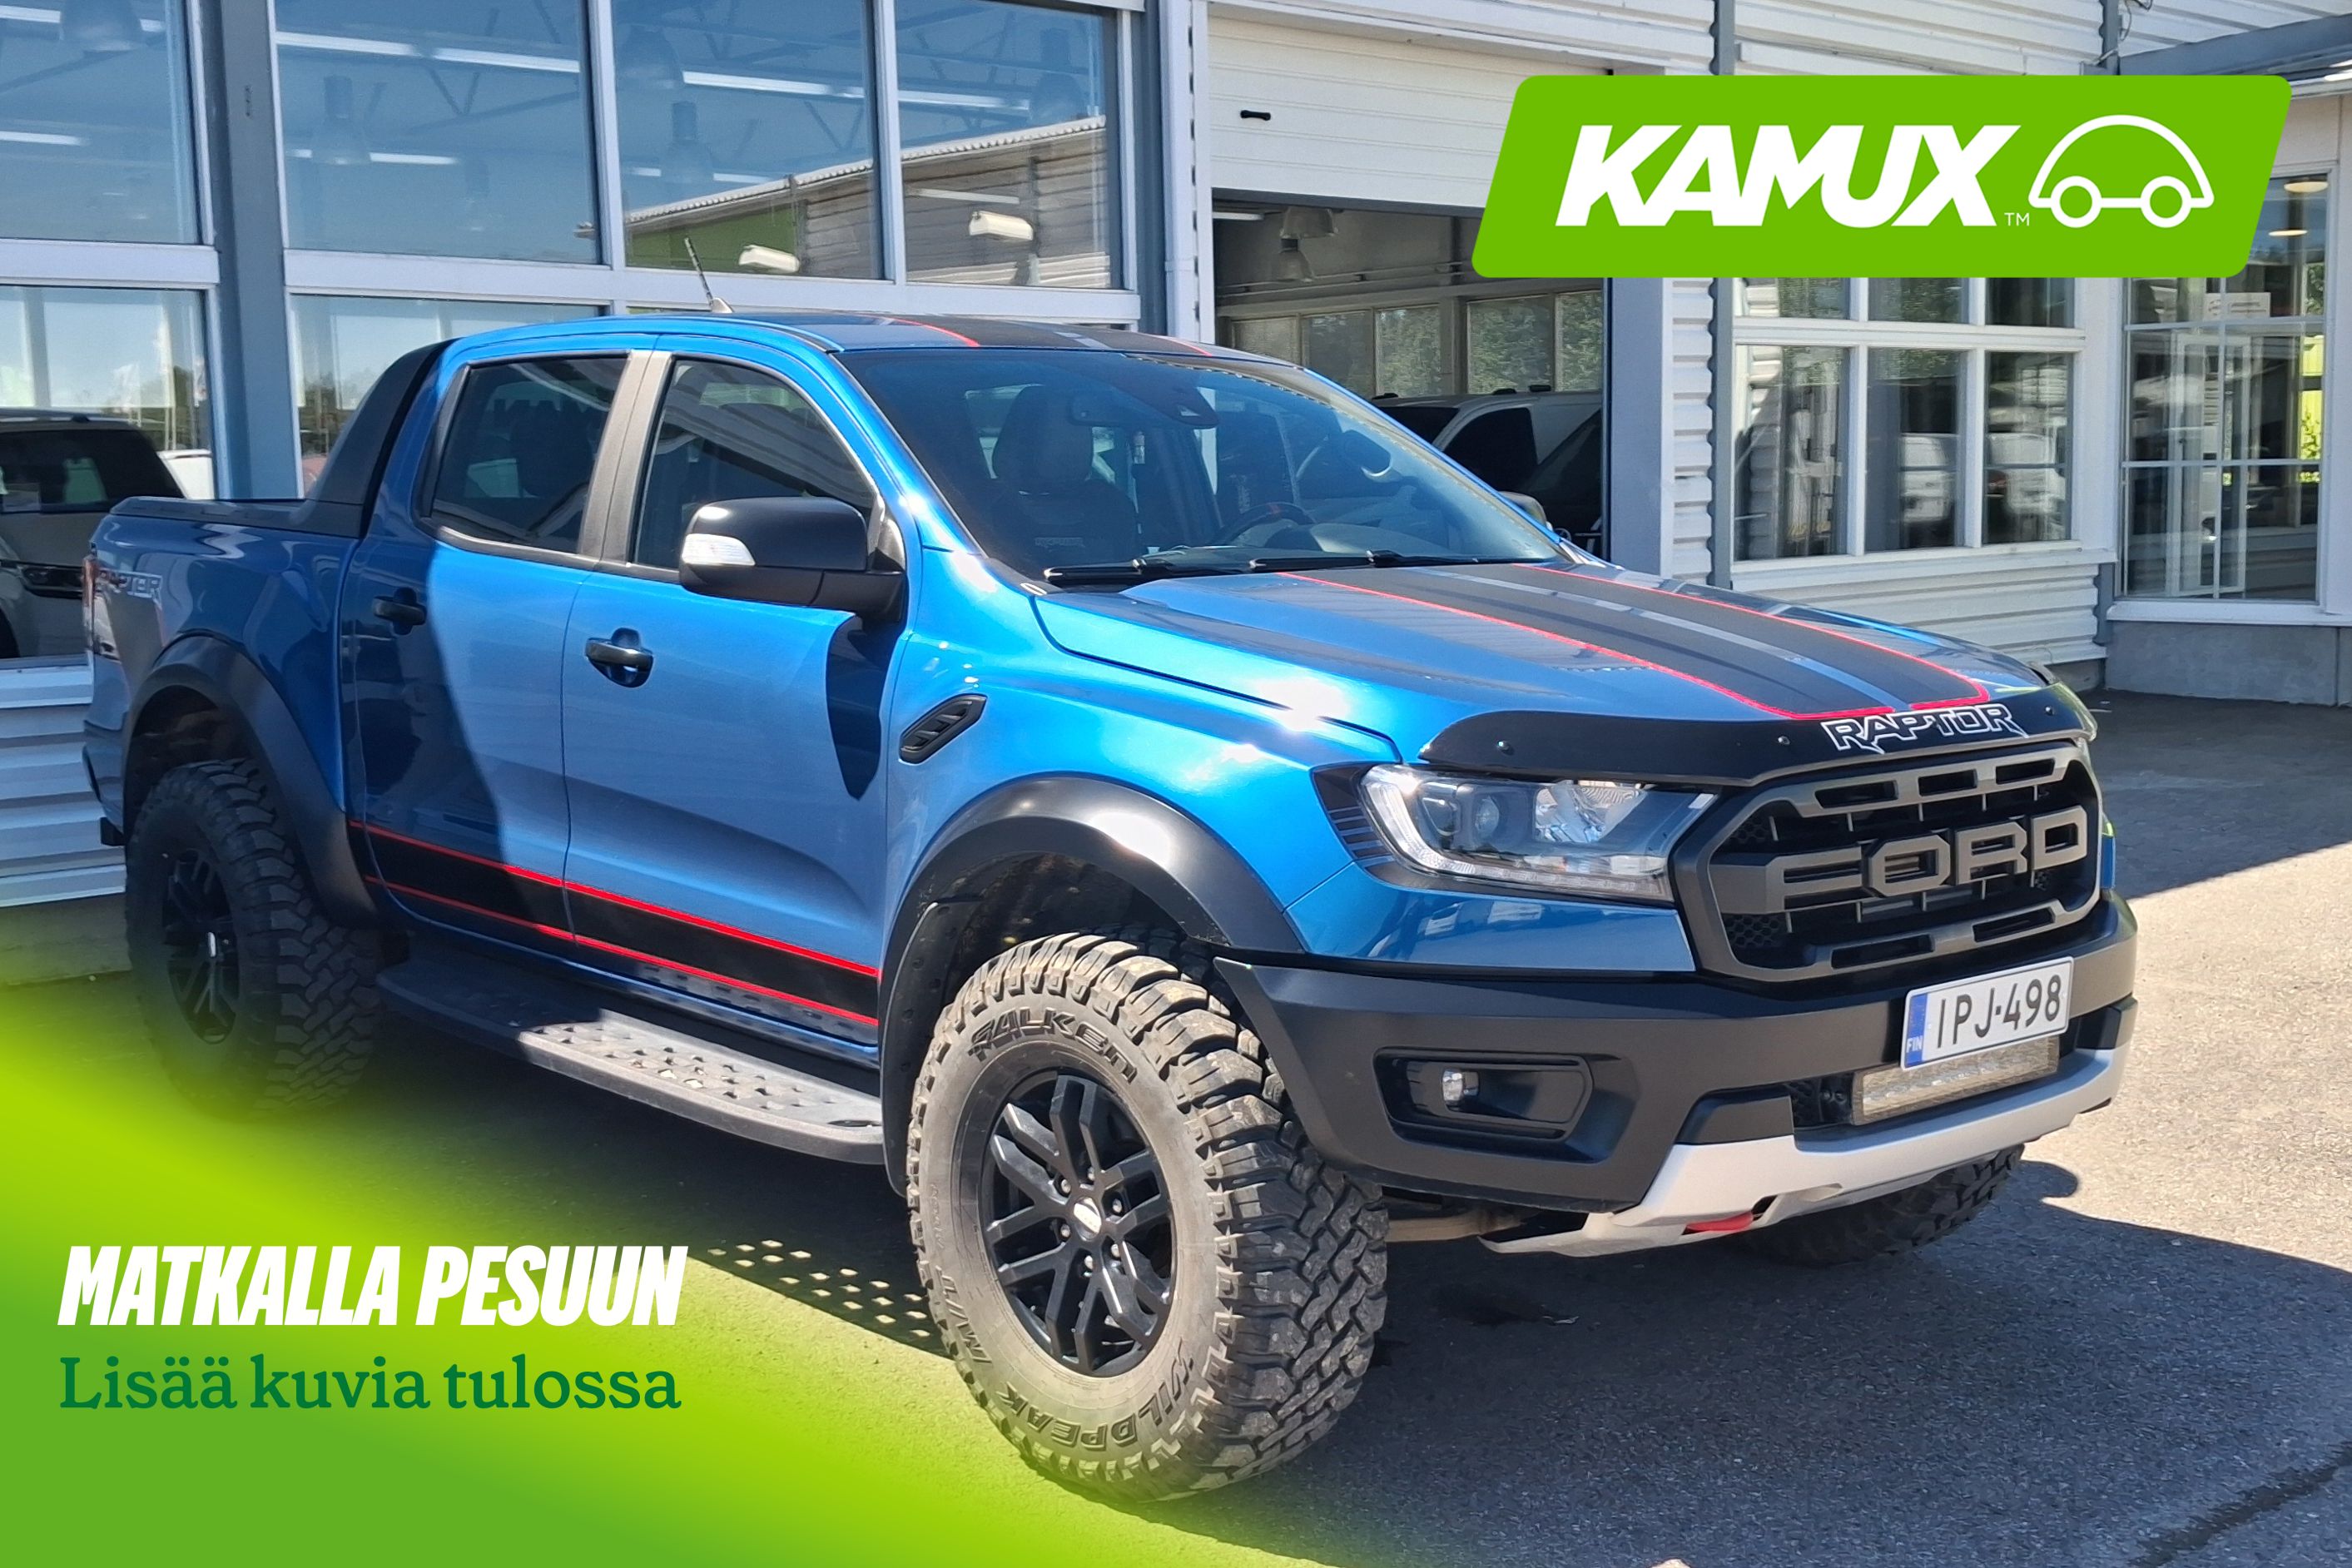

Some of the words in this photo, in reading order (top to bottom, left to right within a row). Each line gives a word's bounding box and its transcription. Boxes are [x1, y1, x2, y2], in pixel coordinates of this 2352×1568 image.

[1820, 703, 2029, 754] RAPTOR
[1764, 805, 2087, 912] FORD
[967, 1006, 1138, 1084] FALKEN
[1907, 1035, 1923, 1054] FIN
[1938, 975, 2062, 1049] IPJ-498
[996, 1337, 1193, 1451] WILDPEAK
